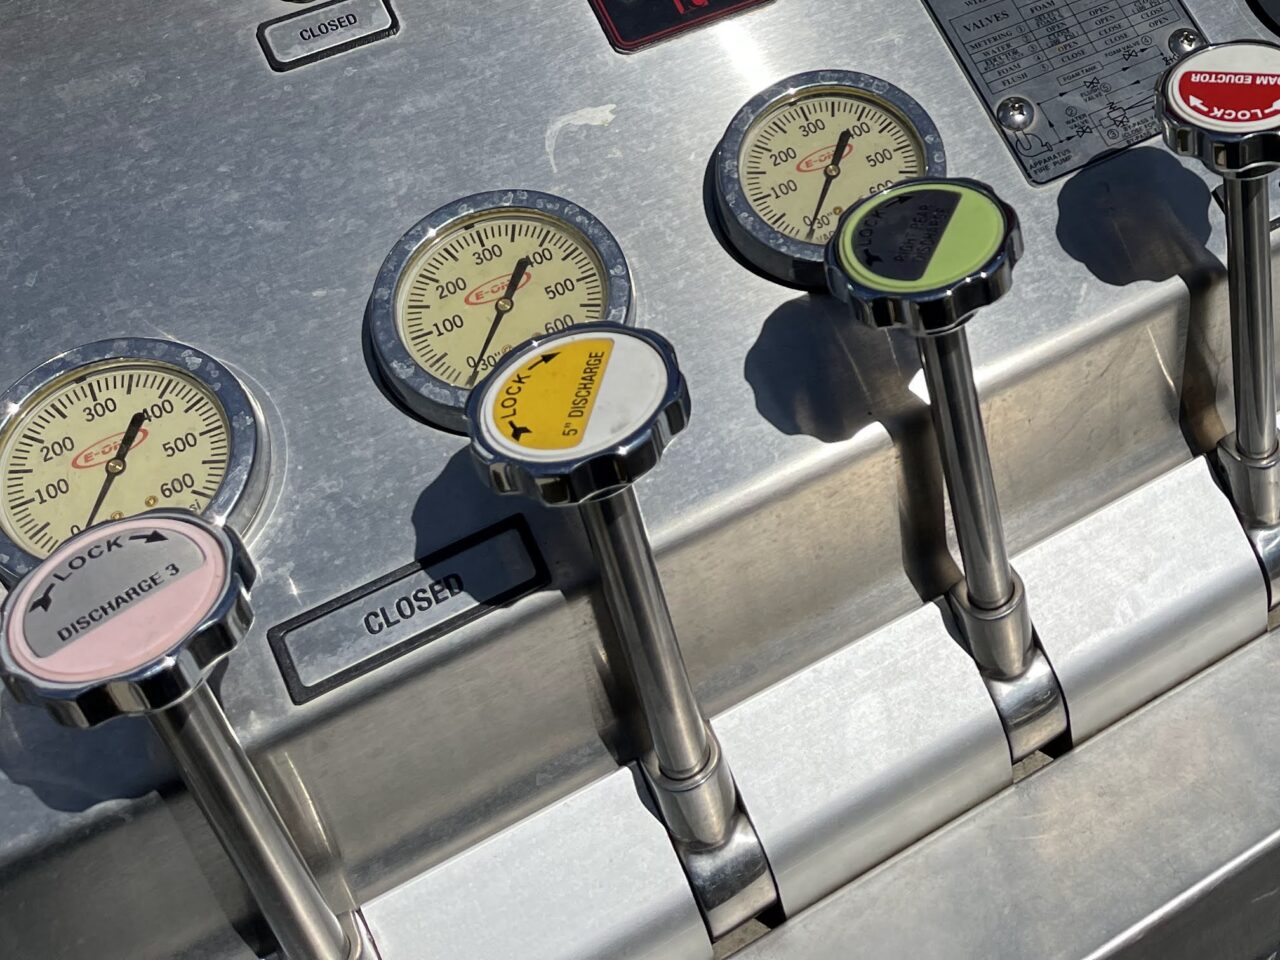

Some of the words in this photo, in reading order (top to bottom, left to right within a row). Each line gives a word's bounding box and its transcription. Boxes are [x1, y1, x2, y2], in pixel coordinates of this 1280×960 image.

[1029, 0, 1056, 14] FOAM
[1088, 4, 1110, 17] OPEN
[1140, 6, 1165, 19] CLOSE
[299, 13, 358, 41] CLOSED
[963, 9, 1010, 34] VALVES
[1045, 20, 1067, 33] OPEN
[1094, 14, 1116, 26] OPEN
[1097, 22, 1123, 36] CLOSE
[1147, 16, 1169, 28] OPEN
[969, 29, 1013, 50] METERING
[1057, 40, 1079, 52] OPEN
[1104, 32, 1129, 46] CLOSE
[1060, 49, 1086, 63] CLOSE
[1001, 72, 1028, 87] FLUSH
[1191, 72, 1252, 84] EDUCTOR
[1211, 108, 1263, 120] LOCK
[798, 119, 826, 137] 300
[769, 147, 797, 167] 200
[866, 149, 893, 168] 500
[1028, 149, 1071, 169] APPARATUS
[1052, 155, 1073, 167] PUMP
[771, 179, 798, 200] 100
[855, 208, 886, 248] LOCK
[472, 244, 503, 265] 300
[435, 277, 467, 300] 200
[544, 278, 575, 300] 500
[432, 314, 464, 337] 100
[544, 314, 574, 335] 600
[466, 355, 475, 369] 0
[568, 351, 605, 418] DISCHARGE
[501, 373, 531, 419] LOCK
[83, 397, 117, 422] 300
[143, 399, 174, 422] 400
[563, 422, 577, 437] 5"
[40, 437, 75, 462] 200
[163, 432, 198, 458] 500
[34, 478, 70, 504] 100
[160, 473, 195, 498] 600
[53, 536, 124, 582] LOCK
[57, 575, 162, 642] DISCHARGE
[168, 563, 181, 576] 3
[363, 573, 464, 635] CLOSED
